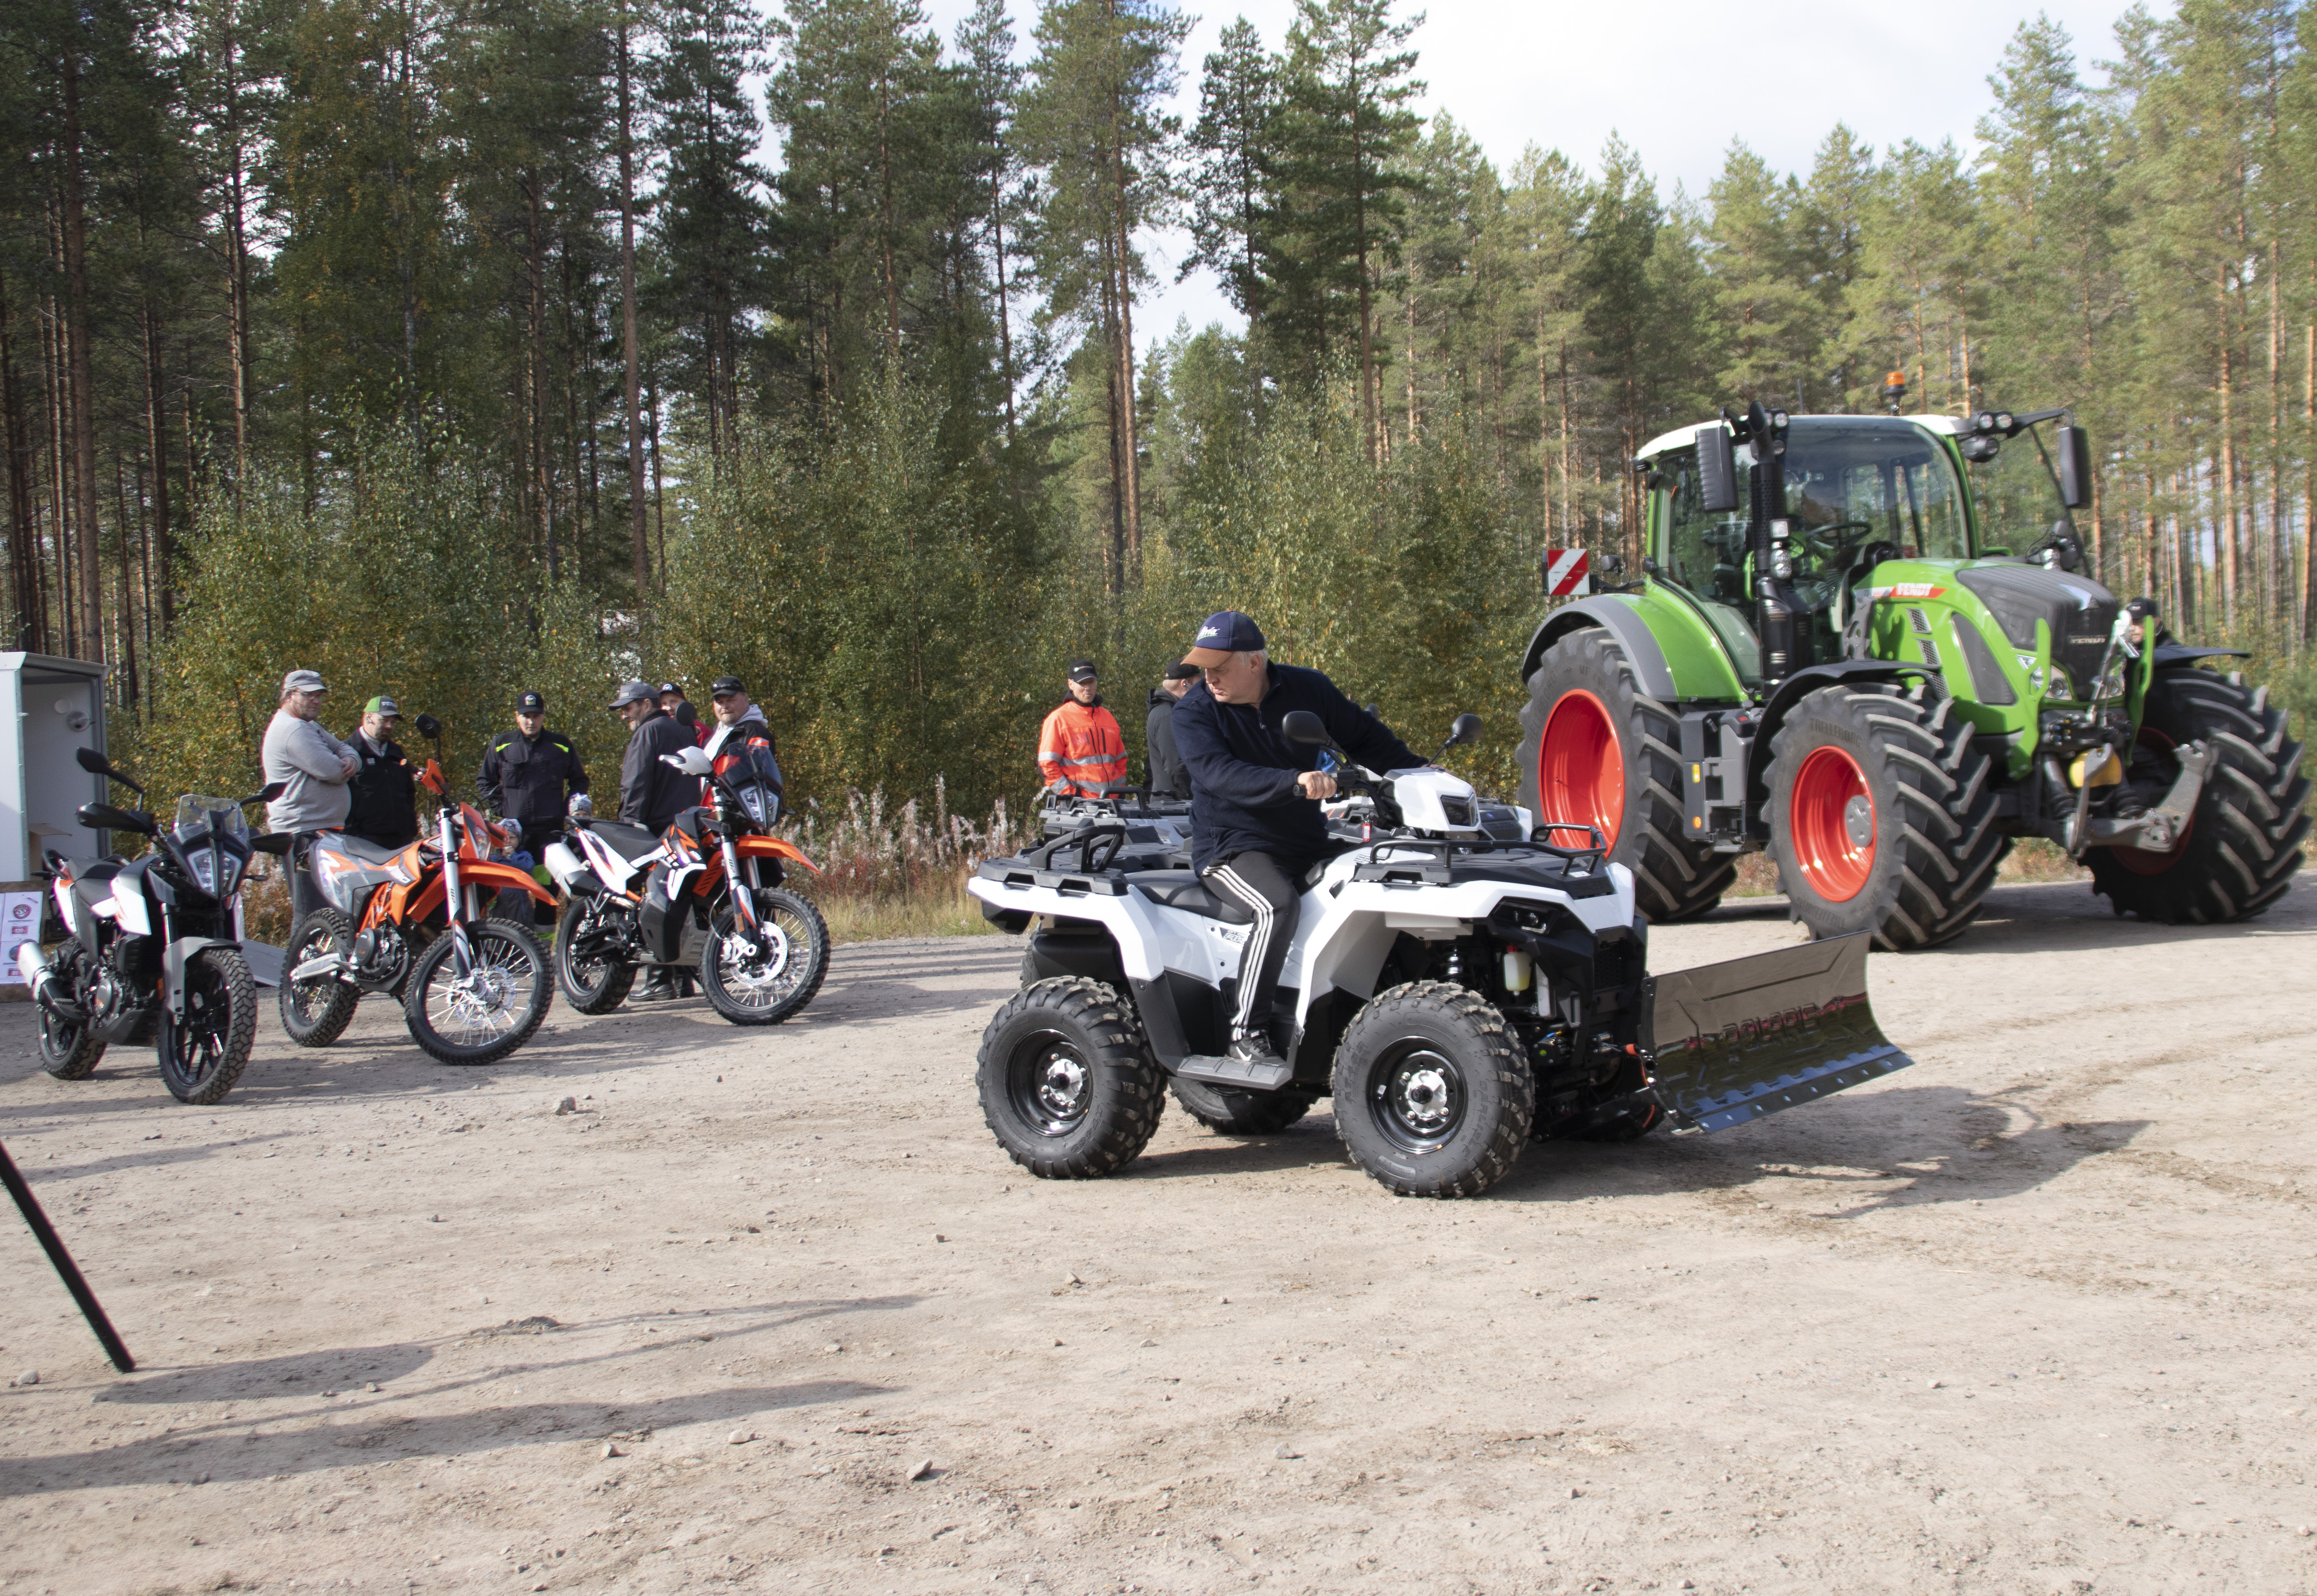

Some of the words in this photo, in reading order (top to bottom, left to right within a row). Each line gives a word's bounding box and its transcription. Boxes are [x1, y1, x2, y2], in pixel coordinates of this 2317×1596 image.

[1896, 582, 1934, 597] FENDT
[1810, 717, 1862, 748] TRELLEBORG
[1722, 1002, 1820, 1051] POLARIS
